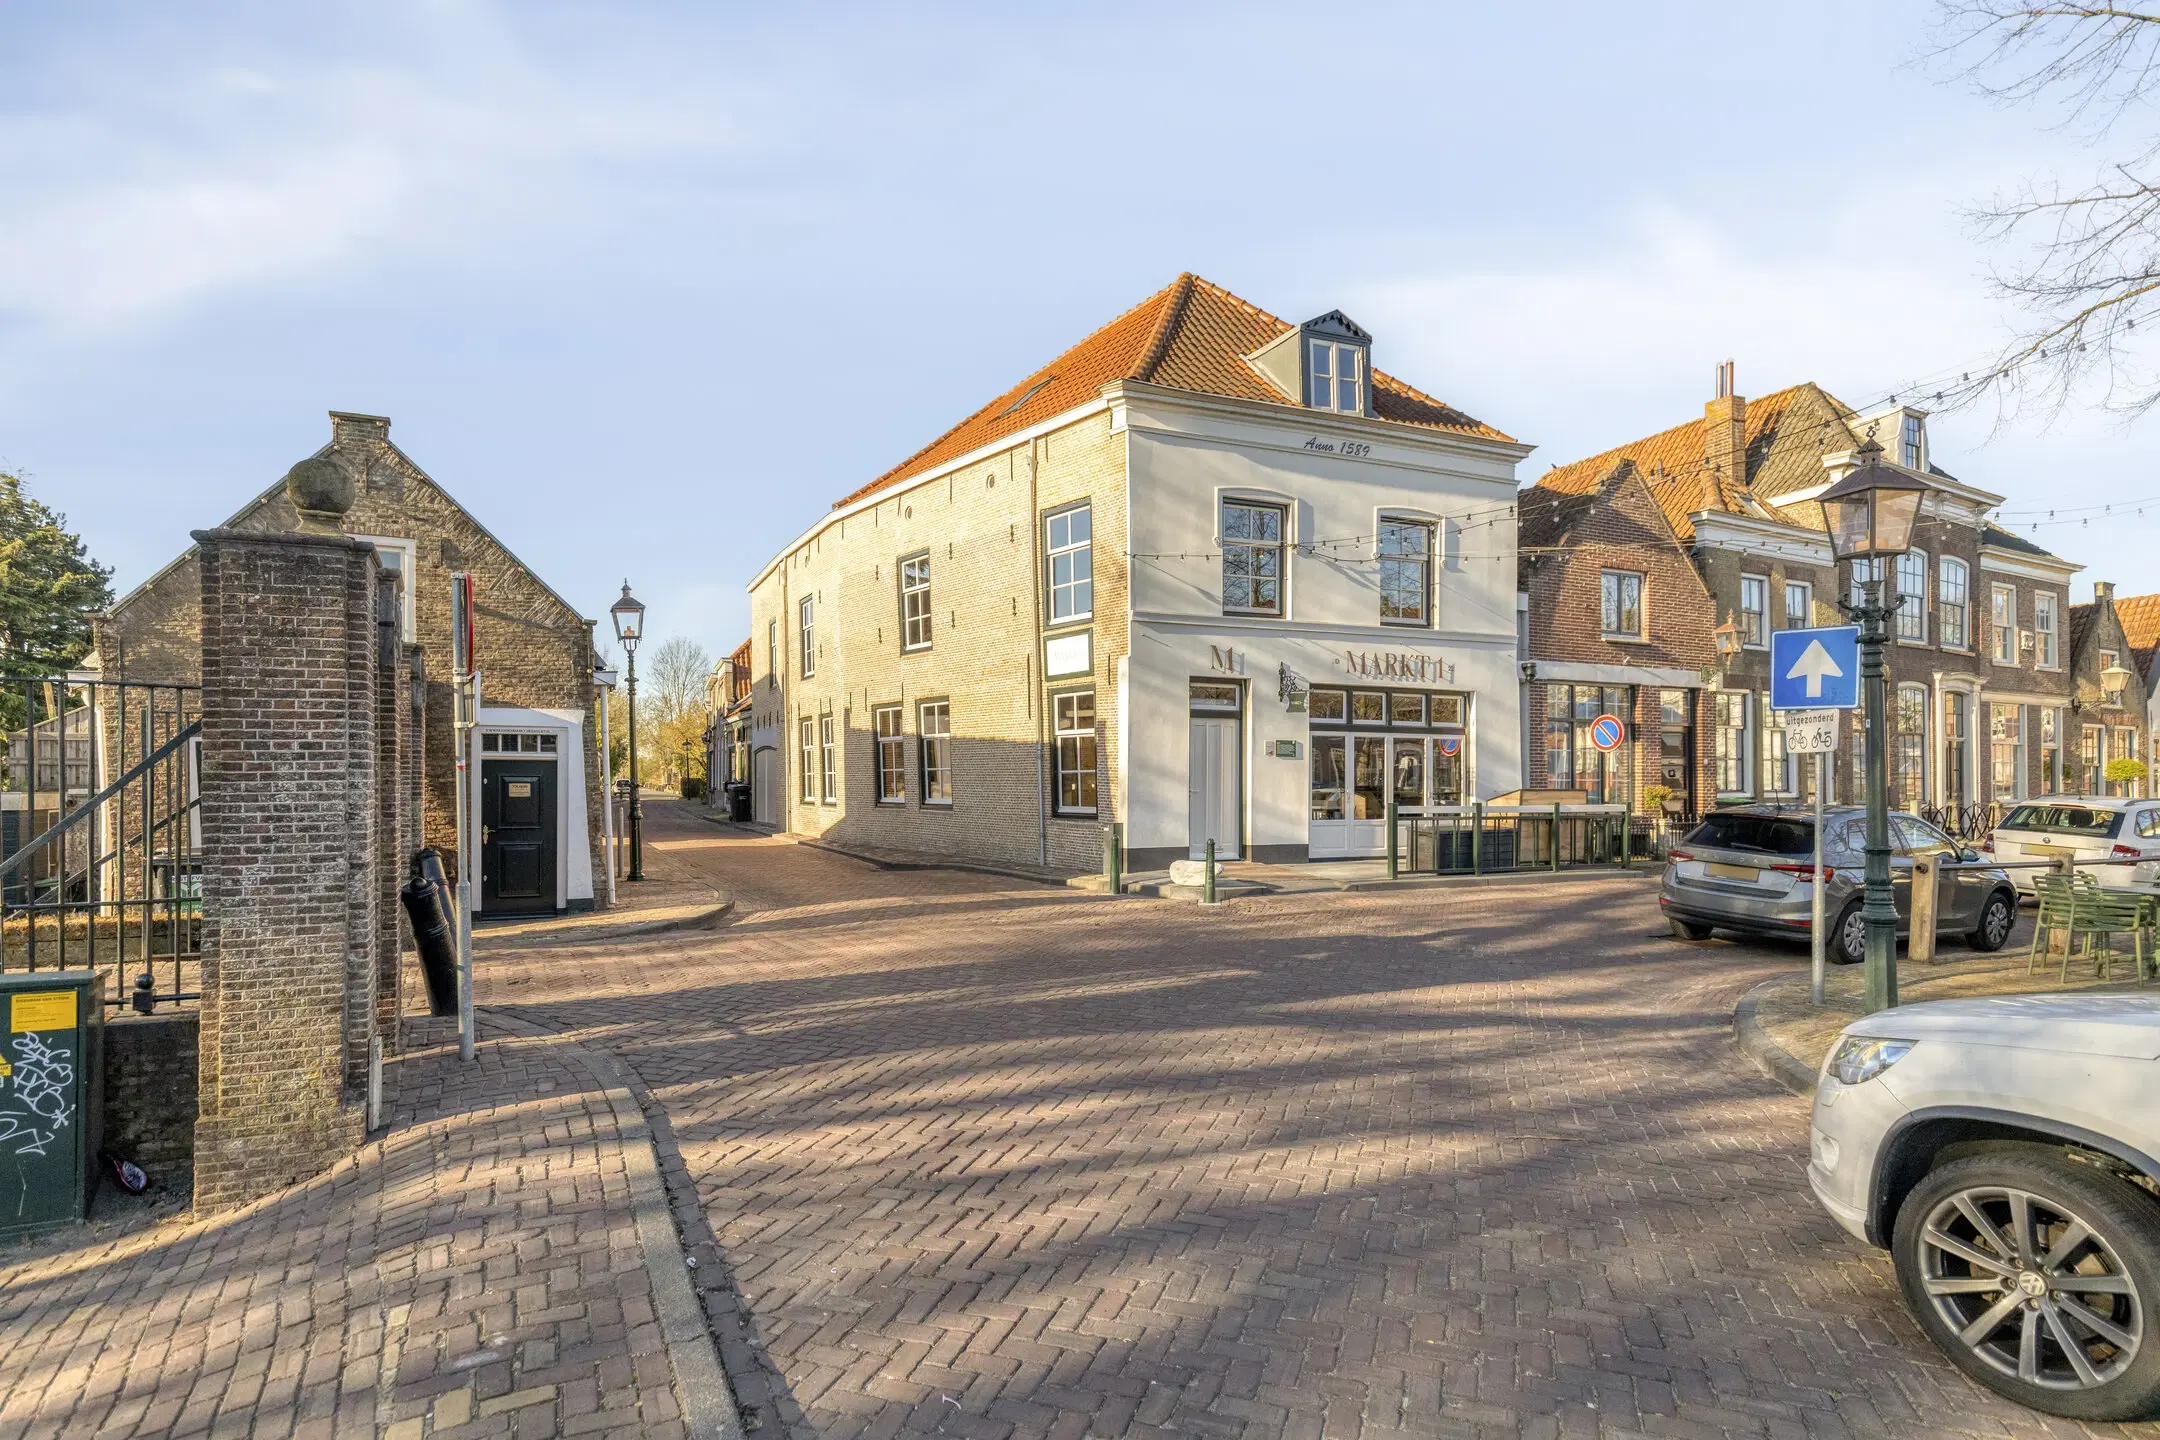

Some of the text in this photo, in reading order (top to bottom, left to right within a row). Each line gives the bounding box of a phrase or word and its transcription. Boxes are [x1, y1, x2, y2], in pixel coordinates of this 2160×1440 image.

[1304, 436, 1370, 457] Anno 1589
[1346, 650, 1430, 679] MARKT
[1786, 713, 1834, 728] uitgezonderd
